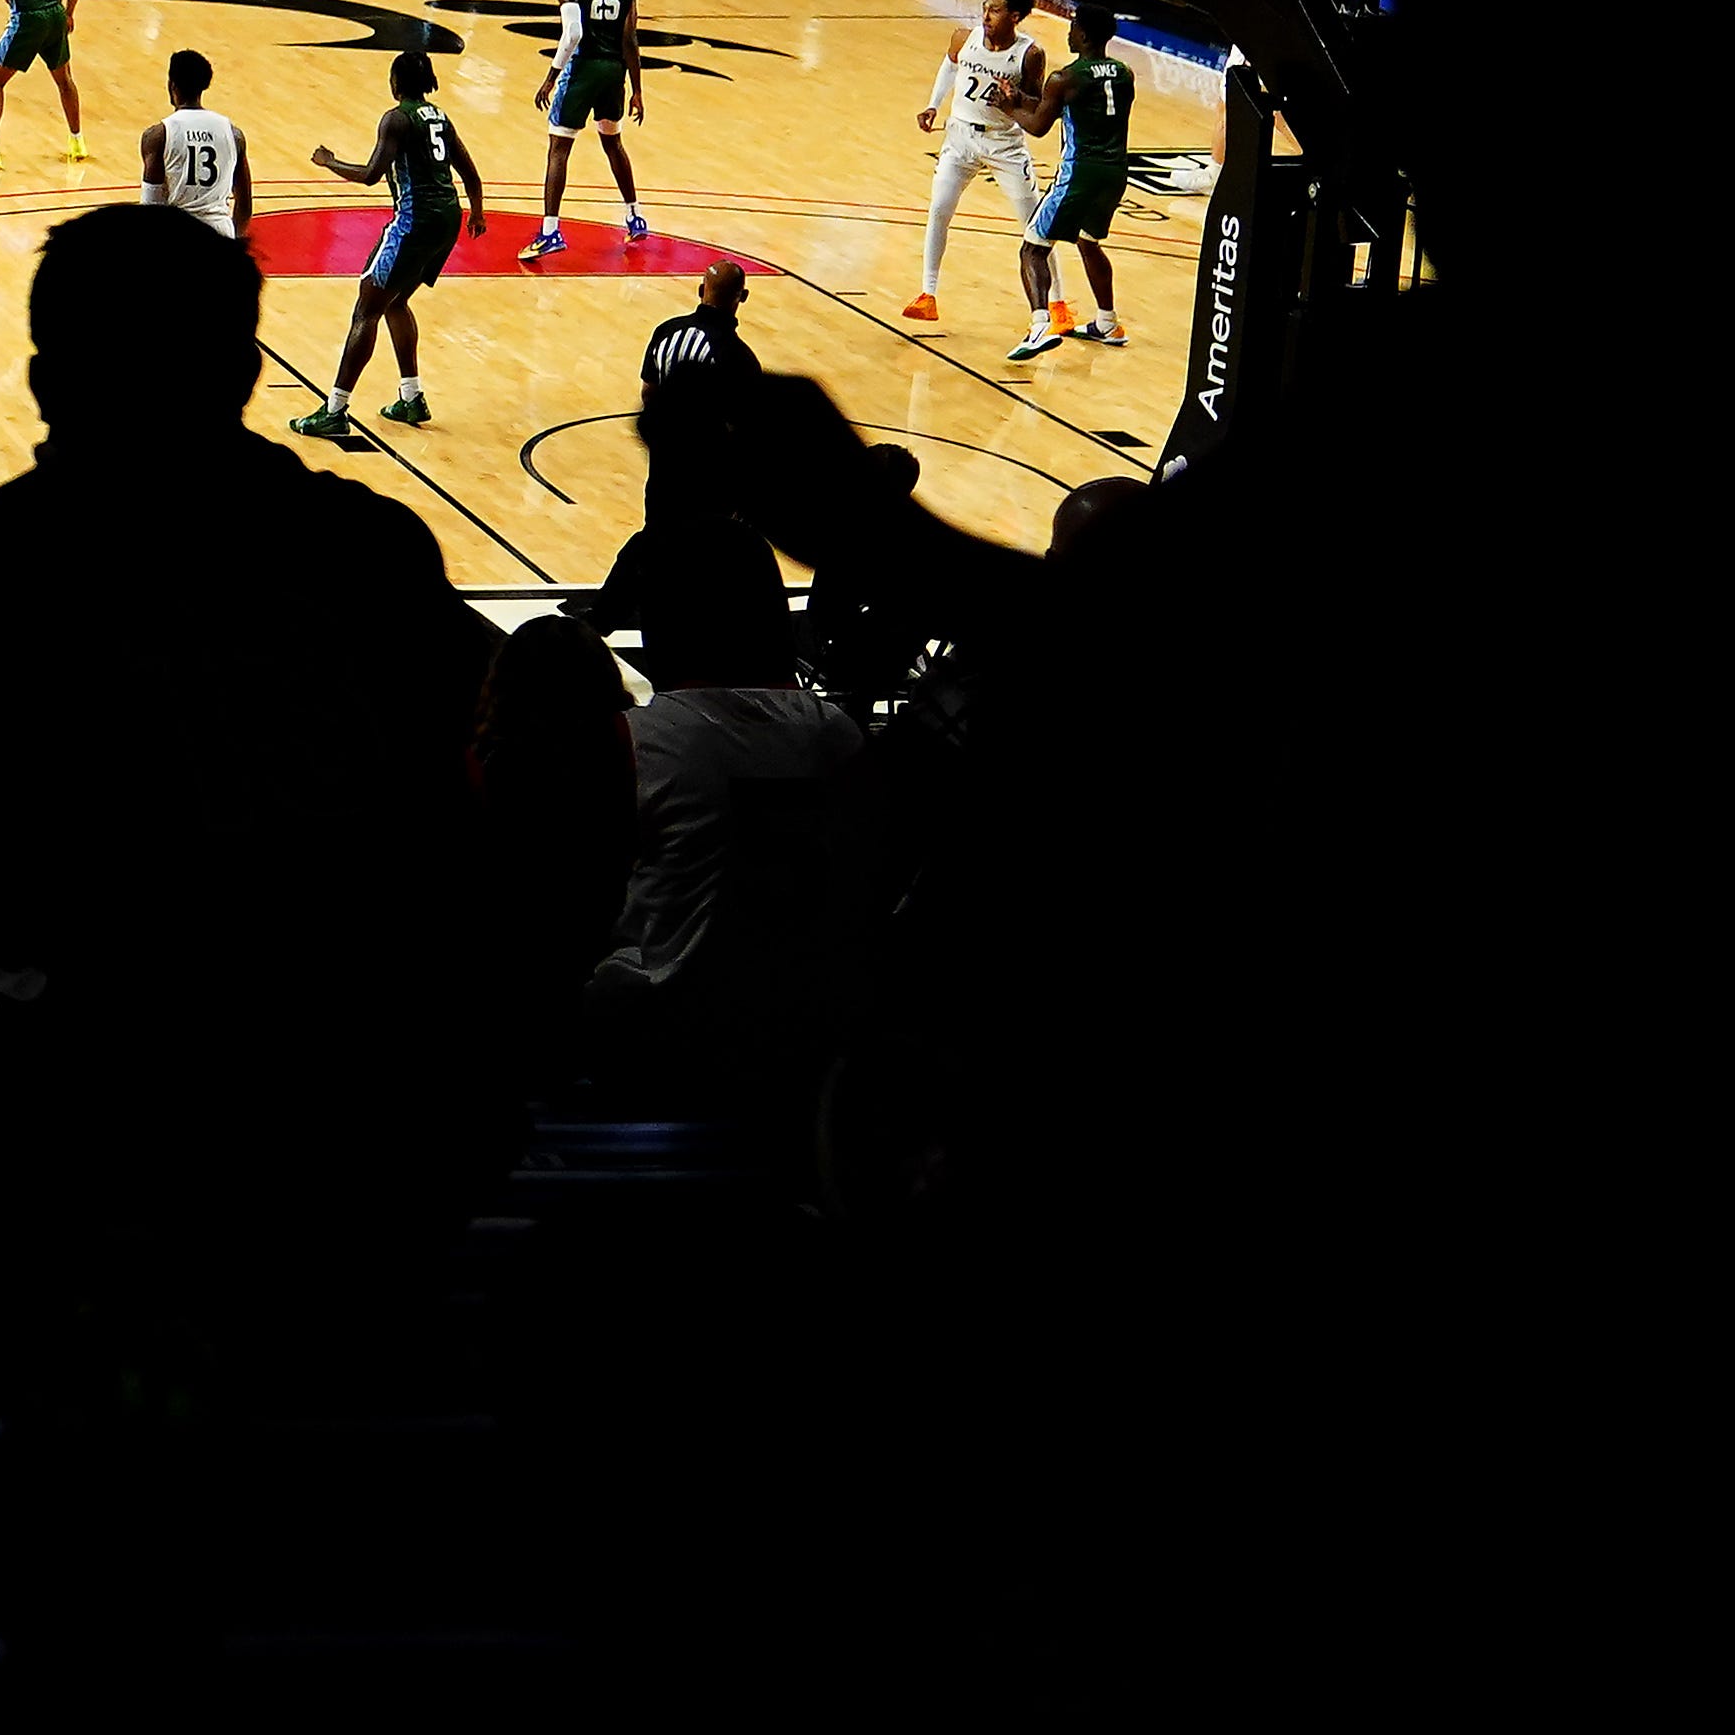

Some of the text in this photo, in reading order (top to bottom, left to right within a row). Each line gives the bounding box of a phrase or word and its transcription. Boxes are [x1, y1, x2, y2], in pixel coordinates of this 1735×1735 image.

[1090, 63, 1118, 79] JAMES
[1103, 79, 1116, 116] 1
[186, 130, 214, 143] EASON
[430, 123, 446, 161] 5
[185, 145, 219, 188] 13
[1198, 215, 1240, 421] Ameritas
